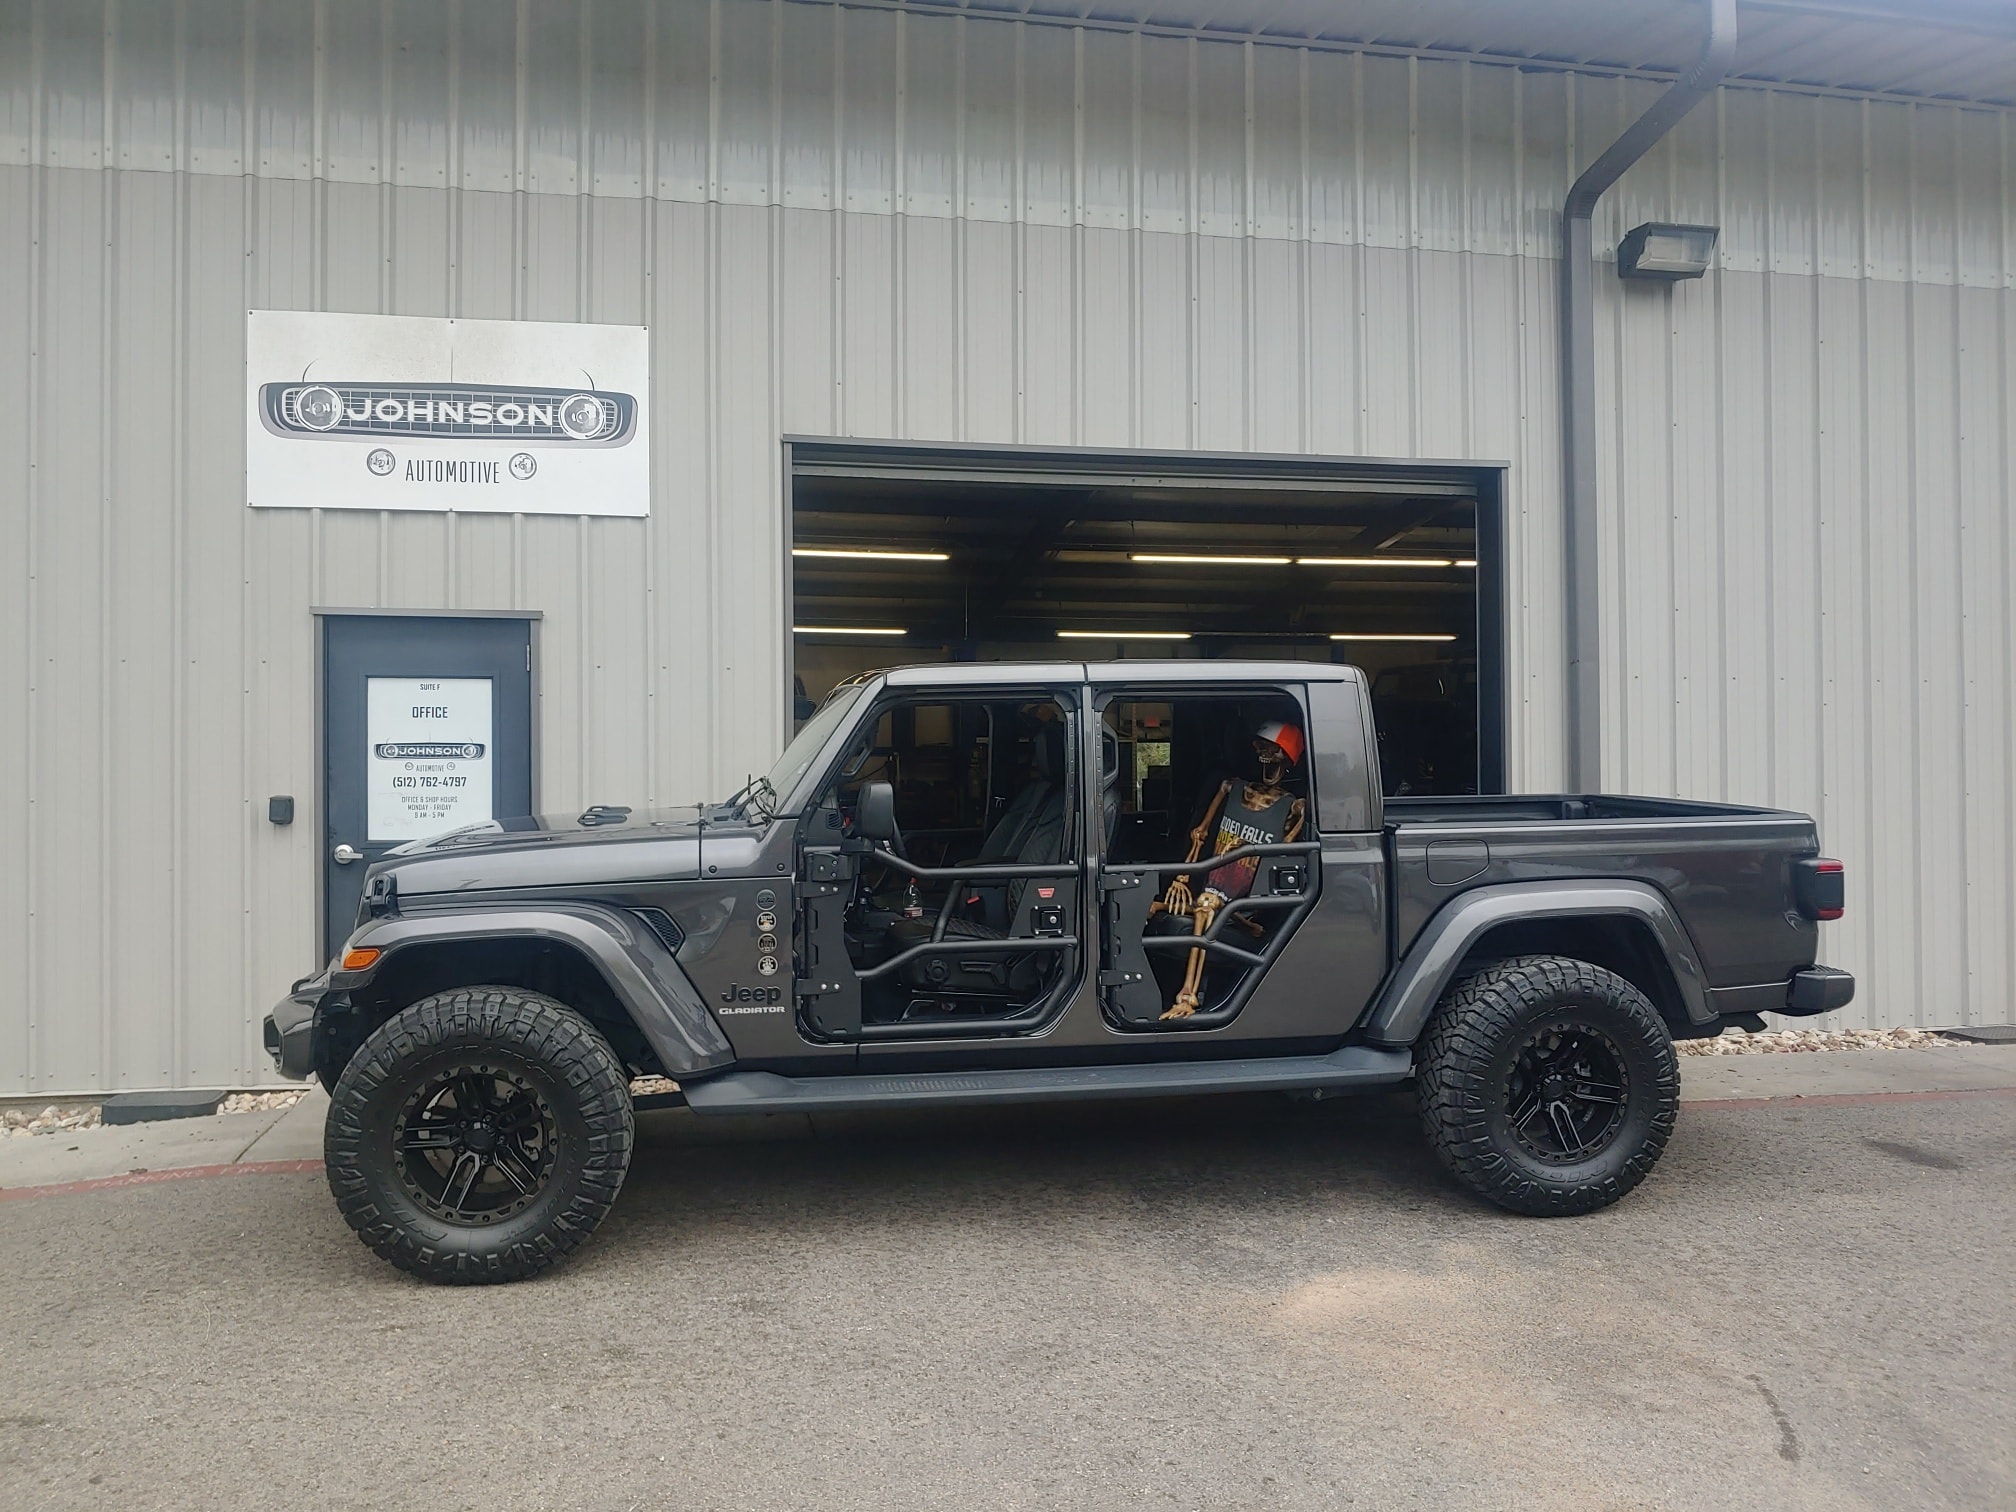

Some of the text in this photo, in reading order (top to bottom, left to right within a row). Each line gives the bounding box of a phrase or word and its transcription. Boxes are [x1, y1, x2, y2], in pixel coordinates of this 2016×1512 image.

[346, 398, 553, 427] JOHNSON
[405, 459, 500, 484] AUTOMOTIVE
[412, 706, 448, 718] OFFICE
[399, 746, 461, 756] JOHNSON
[416, 764, 444, 772] AUTOMOTIVE
[392, 776, 467, 788] (512) 762-4797
[721, 982, 781, 1005] Jeep
[719, 1006, 786, 1015] GLADIATOR
